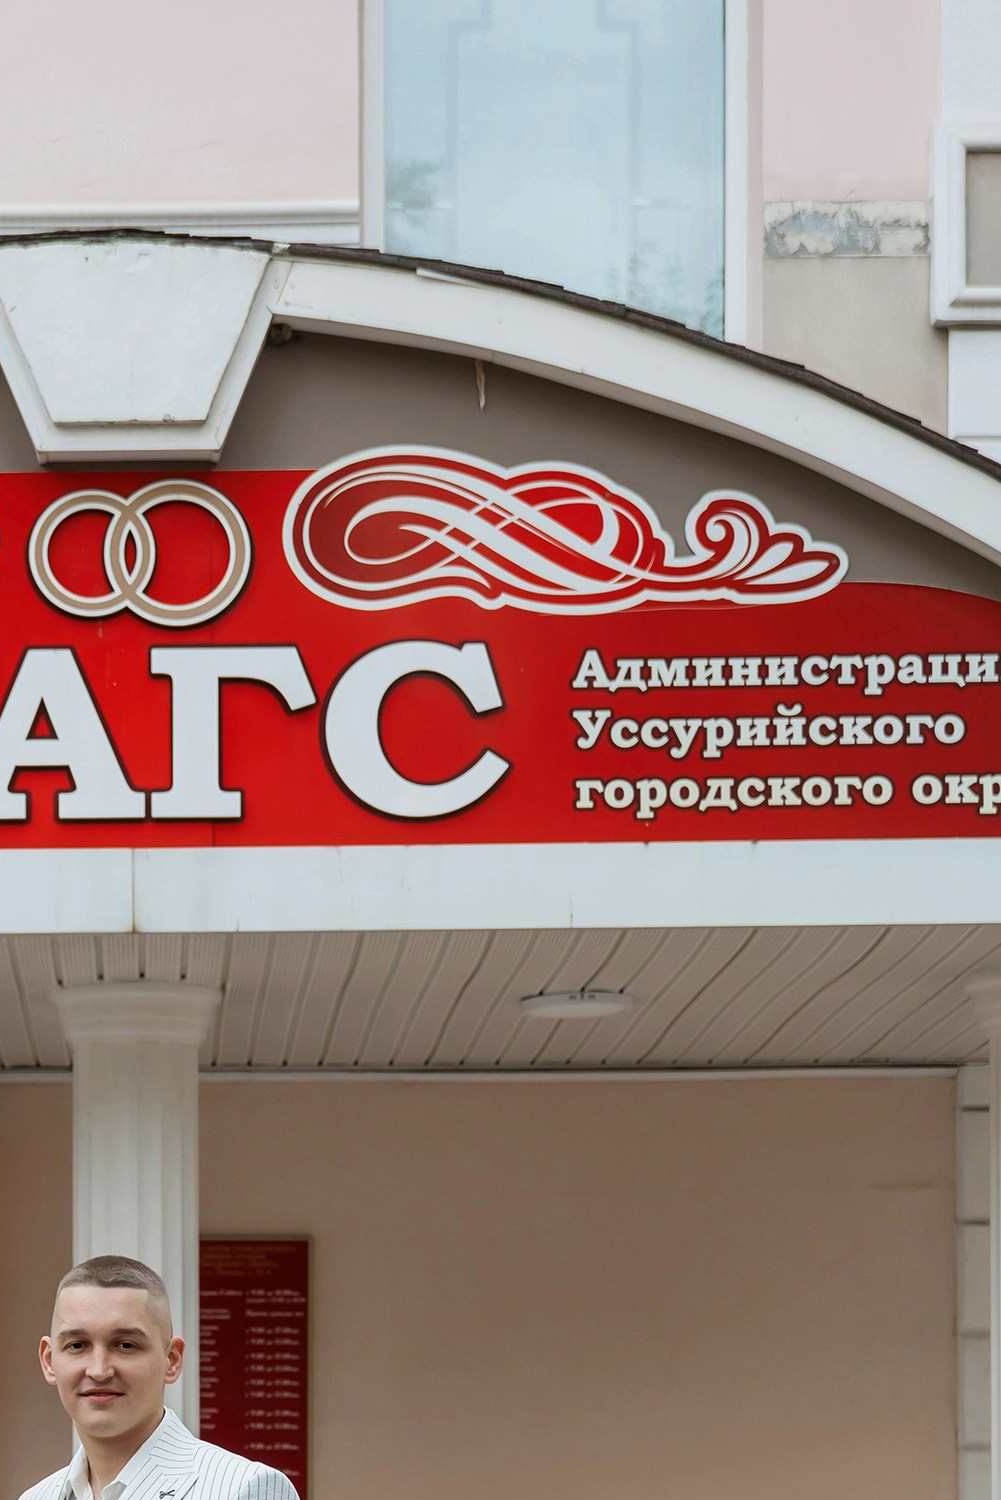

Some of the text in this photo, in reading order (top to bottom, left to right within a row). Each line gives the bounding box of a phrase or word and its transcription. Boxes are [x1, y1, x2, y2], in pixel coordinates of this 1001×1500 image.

[572, 649, 1000, 696] Администраци
[572, 702, 966, 759] Уссурийского
[575, 774, 1001, 819] городского окр
